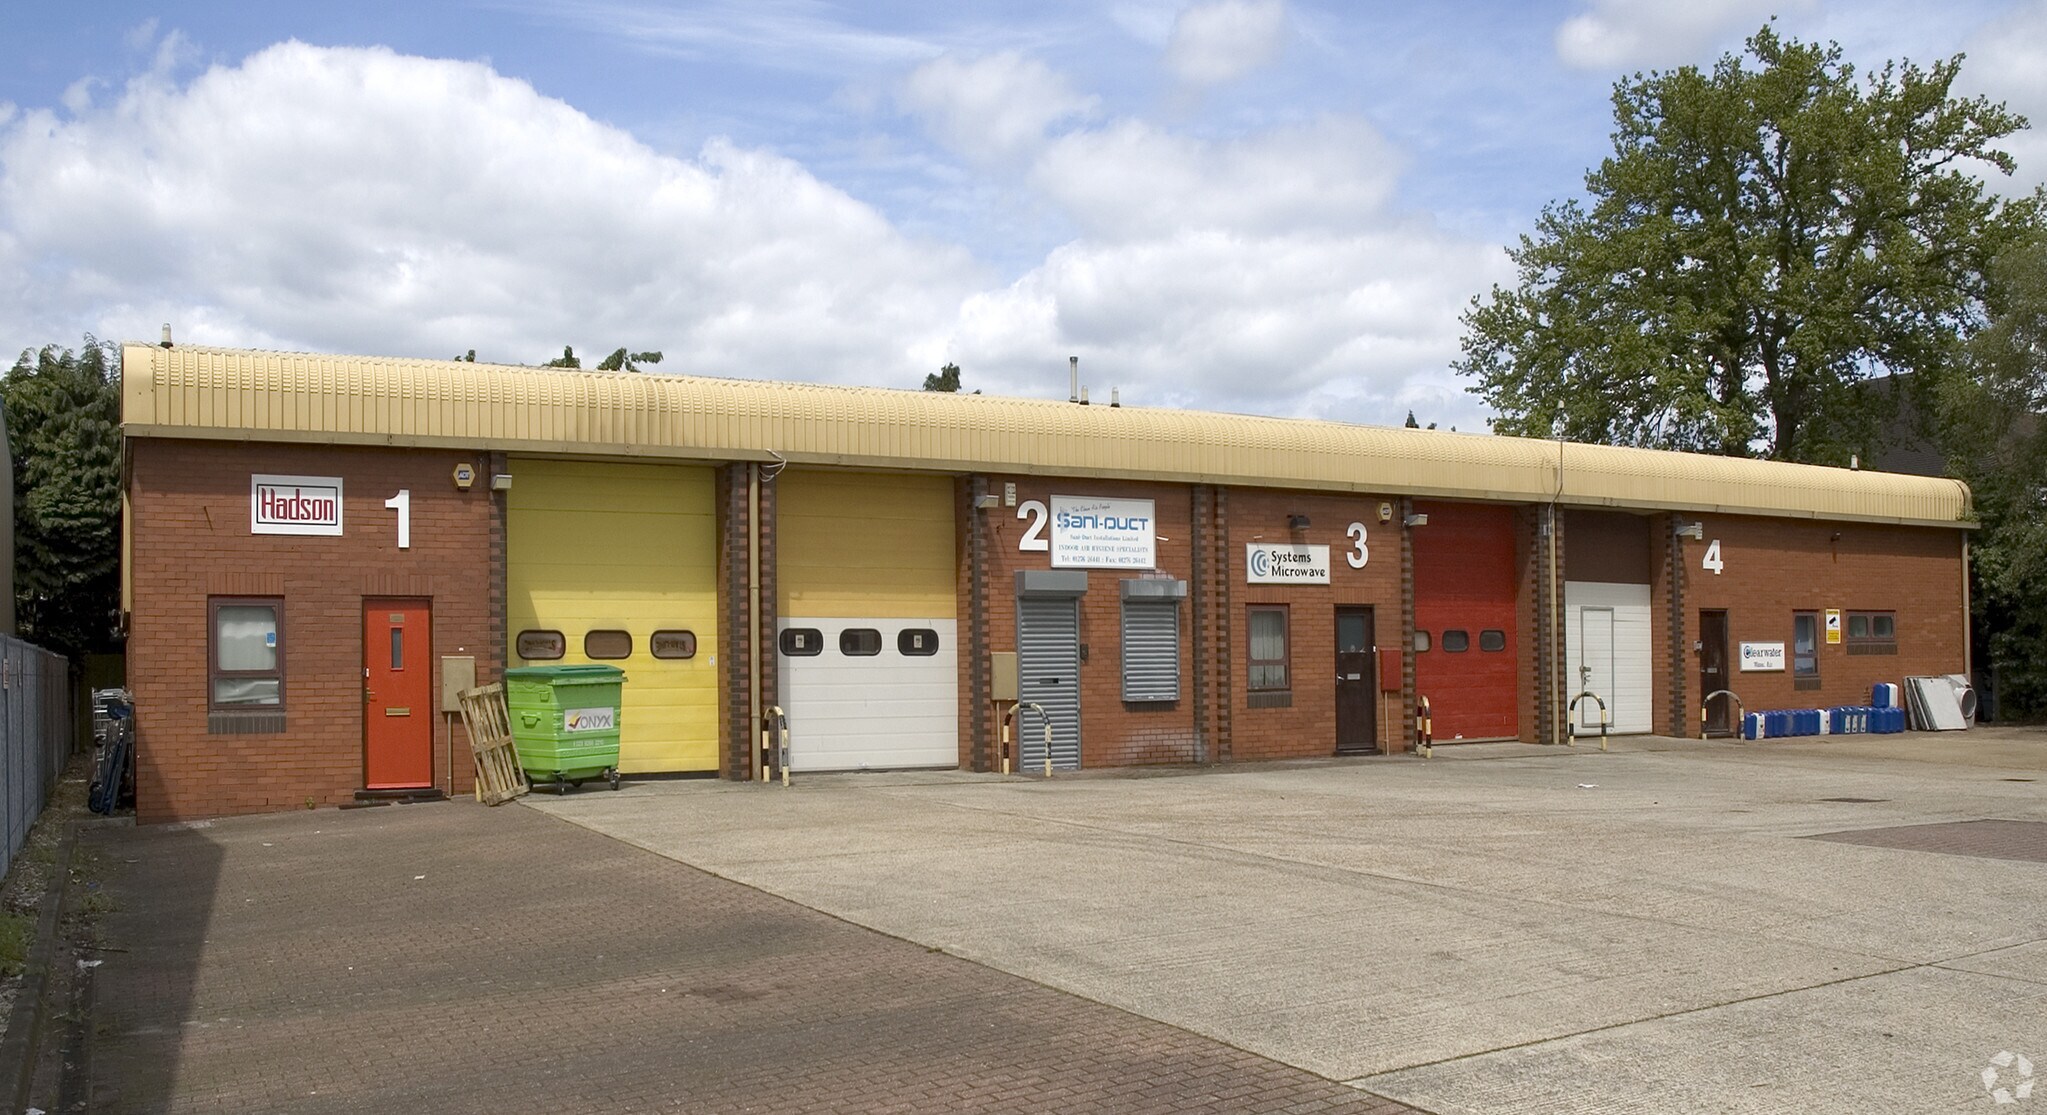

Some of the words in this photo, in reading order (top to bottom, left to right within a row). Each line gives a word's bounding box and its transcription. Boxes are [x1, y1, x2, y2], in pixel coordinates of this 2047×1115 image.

[261, 487, 334, 521] Hadson
[384, 489, 410, 549] 1
[1017, 500, 1048, 551] 2
[1271, 550, 1312, 566] Systems
[1346, 521, 1369, 569] 3
[1702, 539, 1724, 575] 4
[1271, 565, 1326, 577] Microwave
[1743, 645, 1782, 659] Clearwater
[580, 714, 611, 729] ONYX
